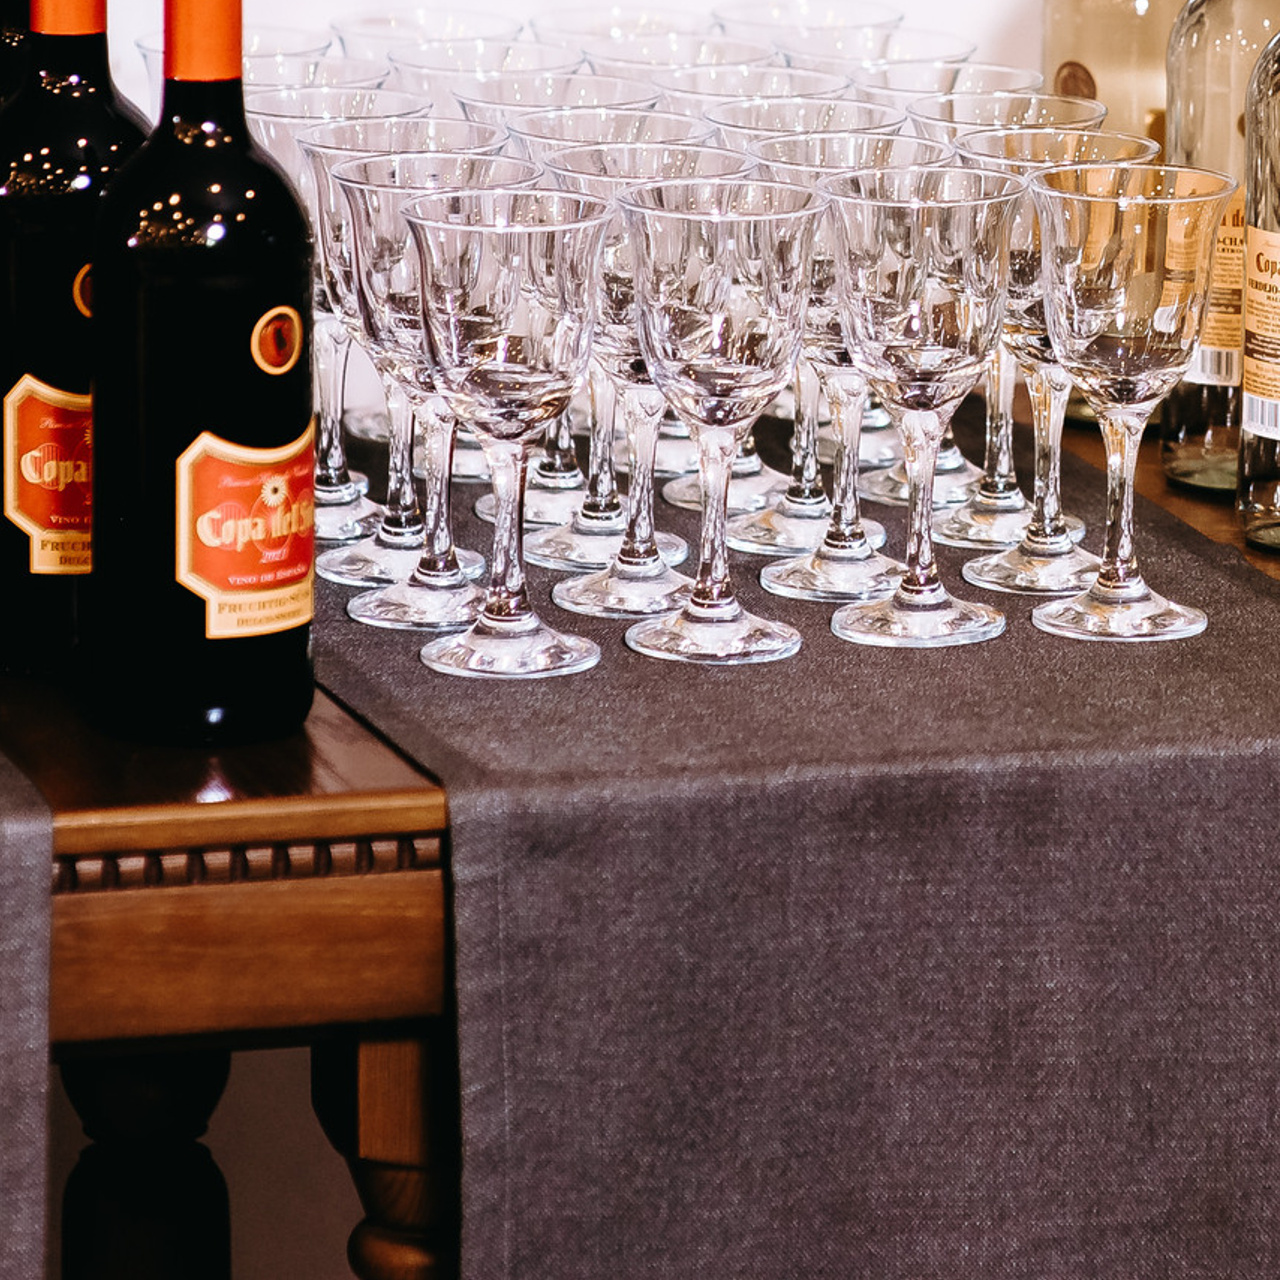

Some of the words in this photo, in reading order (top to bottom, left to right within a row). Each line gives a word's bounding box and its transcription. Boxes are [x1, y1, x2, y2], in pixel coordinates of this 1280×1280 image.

[21, 451, 87, 491] Copa
[197, 510, 266, 552] Copa
[228, 576, 258, 585] VINO
